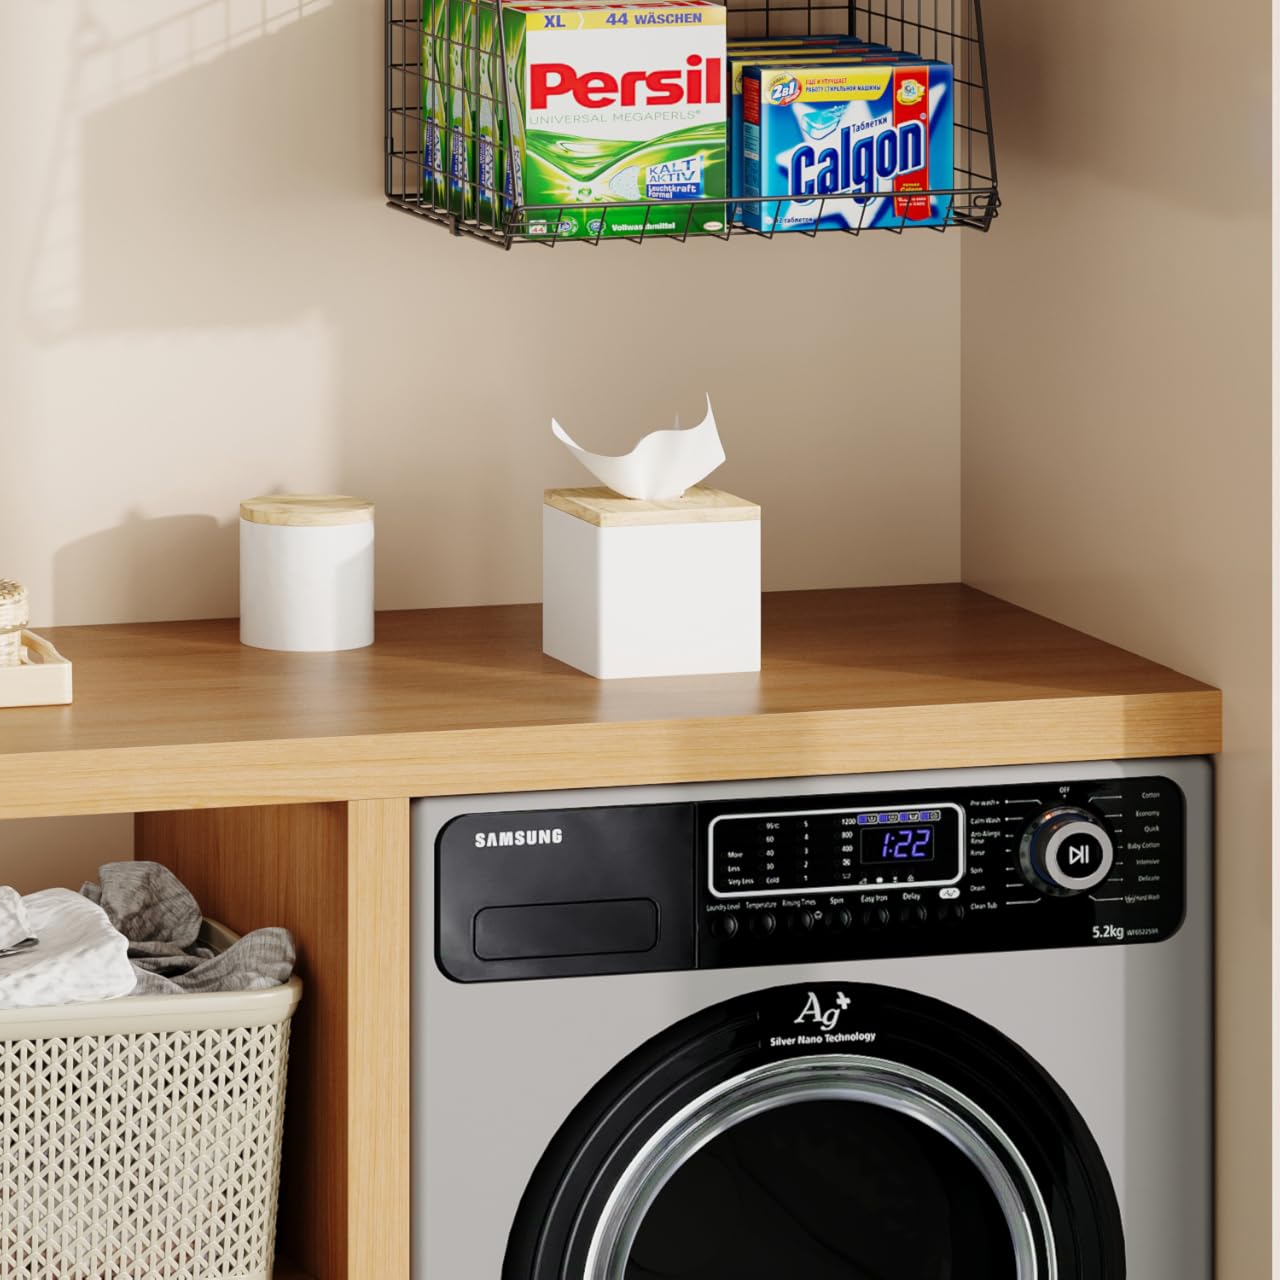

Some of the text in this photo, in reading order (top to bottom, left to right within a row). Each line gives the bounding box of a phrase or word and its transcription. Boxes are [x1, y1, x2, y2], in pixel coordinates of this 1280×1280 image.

[544, 11, 703, 28] XL 44 WÄSCHEN
[530, 54, 721, 110] Persil
[528, 113, 607, 125] UNIVERSAL
[649, 158, 697, 176] KALT
[791, 122, 923, 204] Calgon
[649, 170, 696, 183] AKTIV
[474, 828, 563, 848] SAMSUNG
[882, 830, 930, 858] 1:22
[830, 897, 844, 905] Spin
[1093, 925, 1124, 939] 5.2kg
[770, 1031, 876, 1047] Silver Nano Technology
